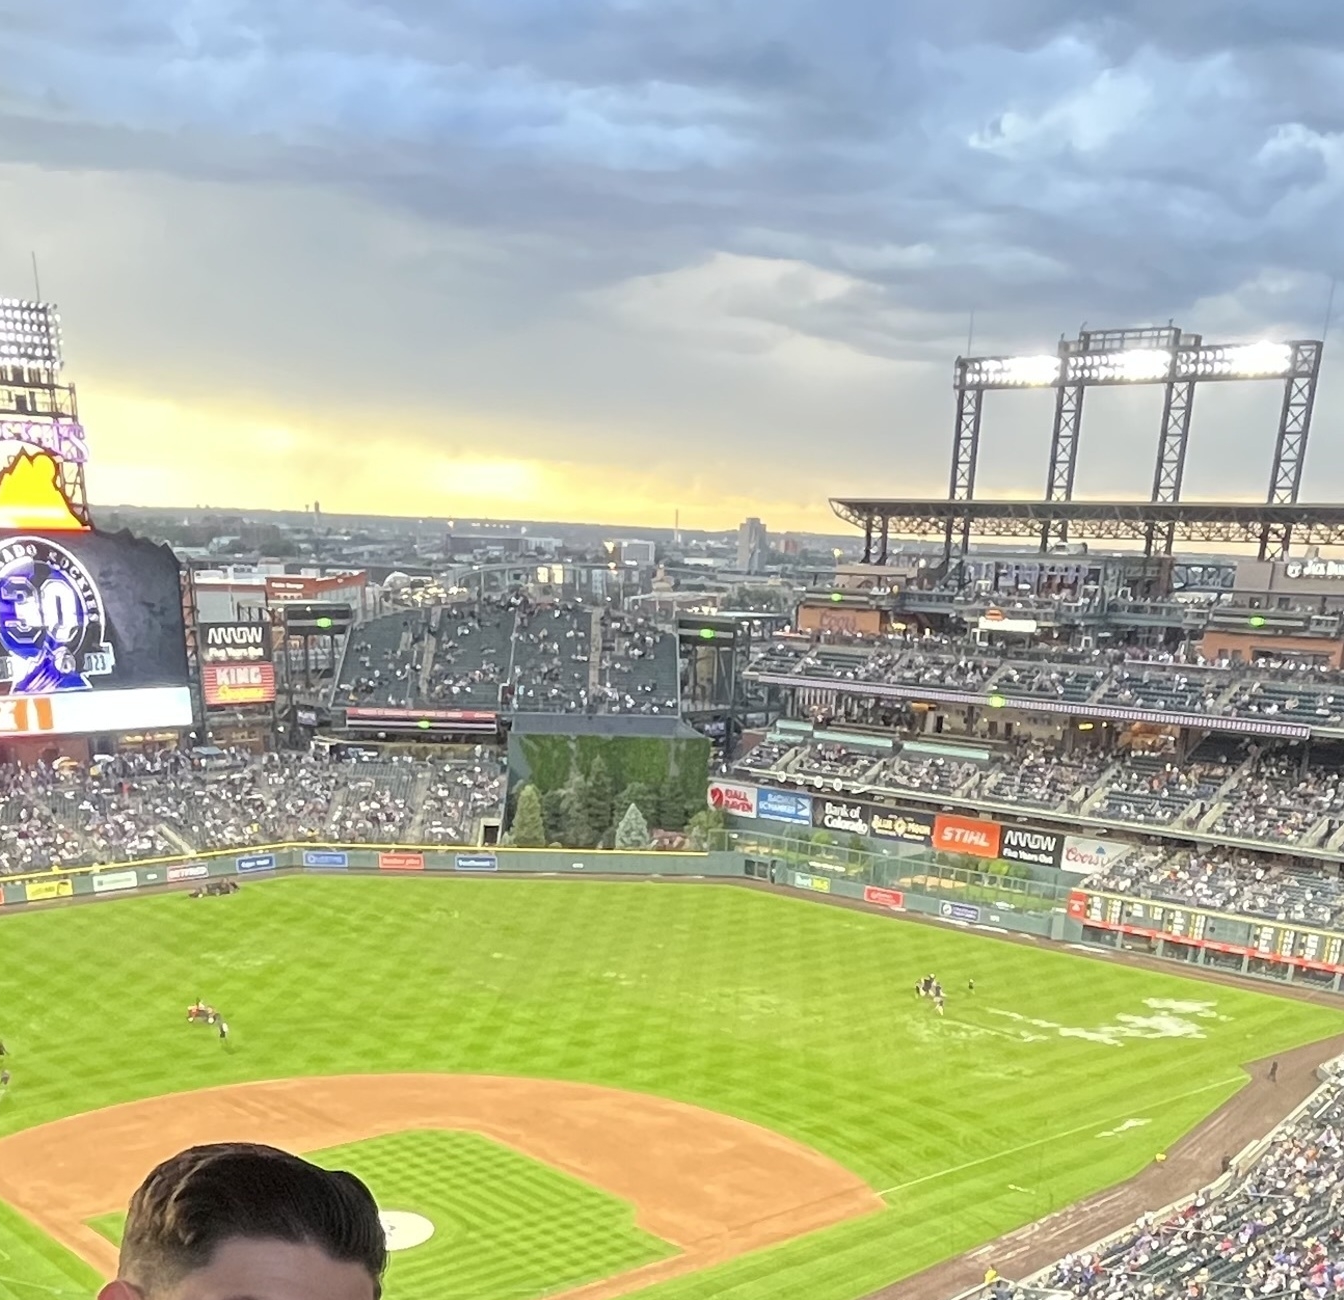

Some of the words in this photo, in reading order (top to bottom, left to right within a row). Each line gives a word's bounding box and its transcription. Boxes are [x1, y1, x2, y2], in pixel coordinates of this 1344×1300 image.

[48, 551, 99, 622] ROCKIES
[1, 576, 80, 644] 30
[216, 667, 262, 685] KING
[824, 802, 848, 818] Bank
[850, 805, 861, 819] of
[824, 815, 868, 835] Colorado
[942, 826, 990, 847] STIHL
[1004, 830, 1057, 852] ARROW
[1019, 851, 1039, 863] Years
[1039, 853, 1053, 865] Out
[1066, 845, 1099, 865] Coors
